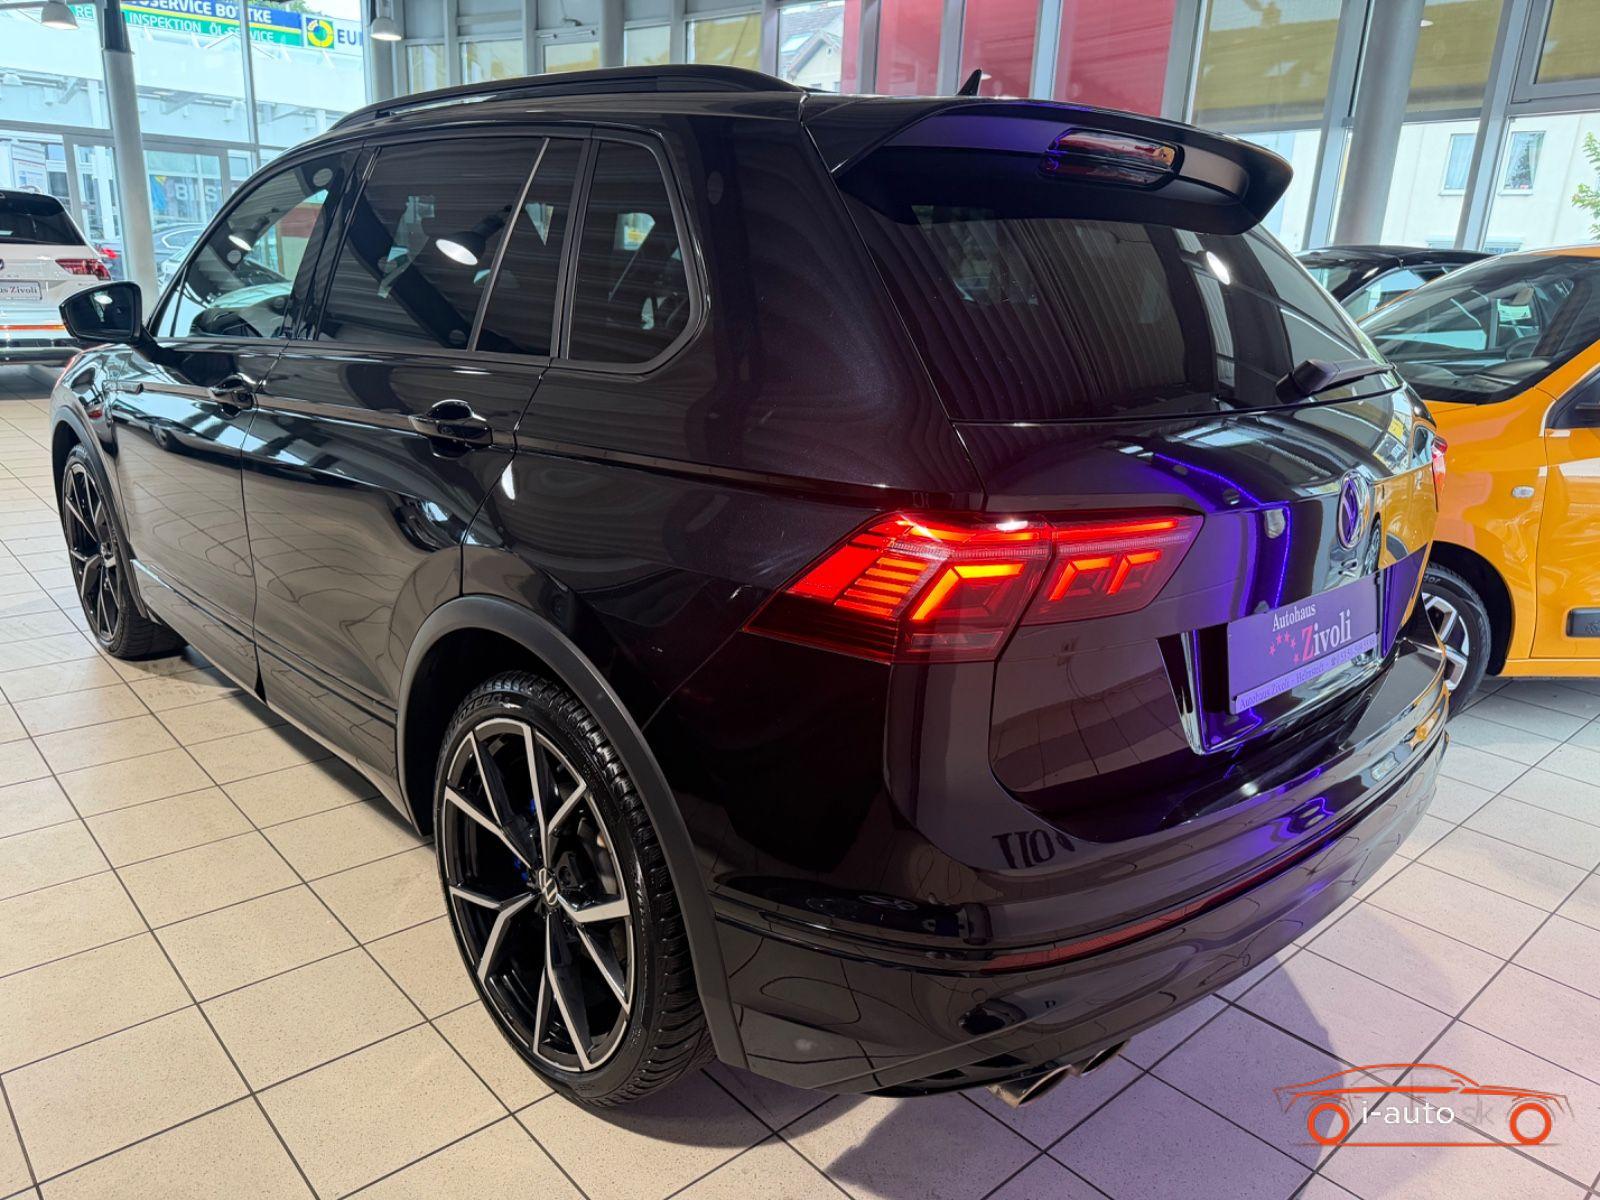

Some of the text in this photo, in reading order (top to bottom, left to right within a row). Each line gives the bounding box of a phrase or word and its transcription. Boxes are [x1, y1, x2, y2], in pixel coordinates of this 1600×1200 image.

[129, 12, 202, 33] INSPEKTION
[1272, 603, 1316, 631] Autohaus
[1301, 609, 1351, 661] Zivoli
